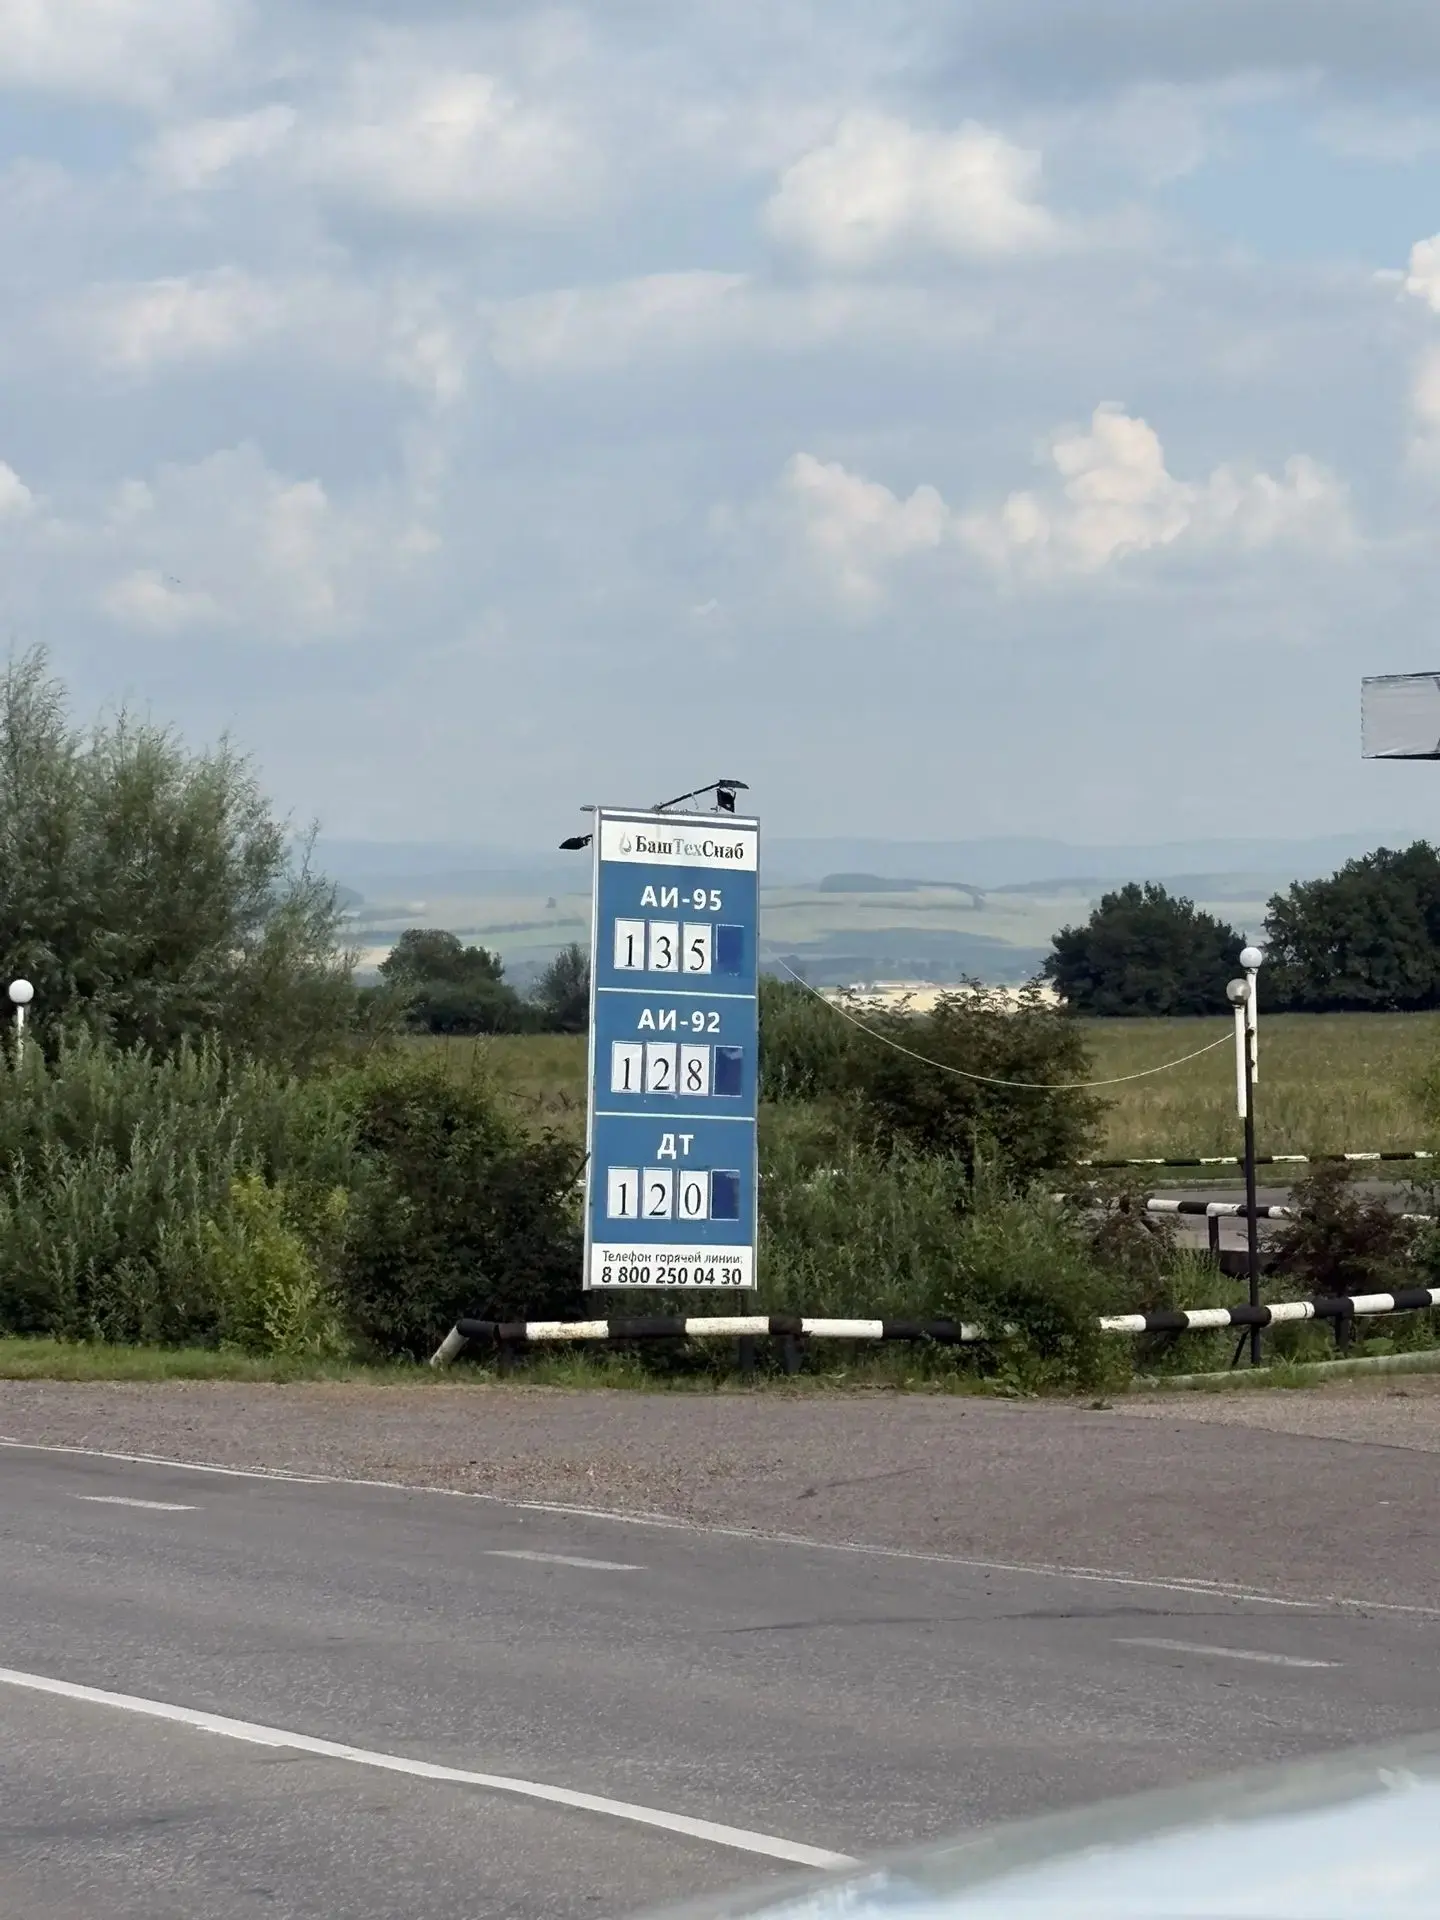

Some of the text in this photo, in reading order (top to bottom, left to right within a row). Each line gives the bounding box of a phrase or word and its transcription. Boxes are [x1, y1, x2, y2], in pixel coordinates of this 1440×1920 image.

[635, 835, 744, 860] БашТехСнаб
[640, 885, 722, 911] АИ-95
[624, 934, 706, 971] 135
[637, 1008, 721, 1033] АИ-92
[622, 1057, 703, 1092] 128
[657, 1133, 694, 1160] ДТ
[618, 1182, 702, 1216] 120
[602, 1250, 651, 1265] Телефон
[655, 1251, 702, 1265] горячей
[601, 1266, 742, 1285] 8 800 250 04 30
